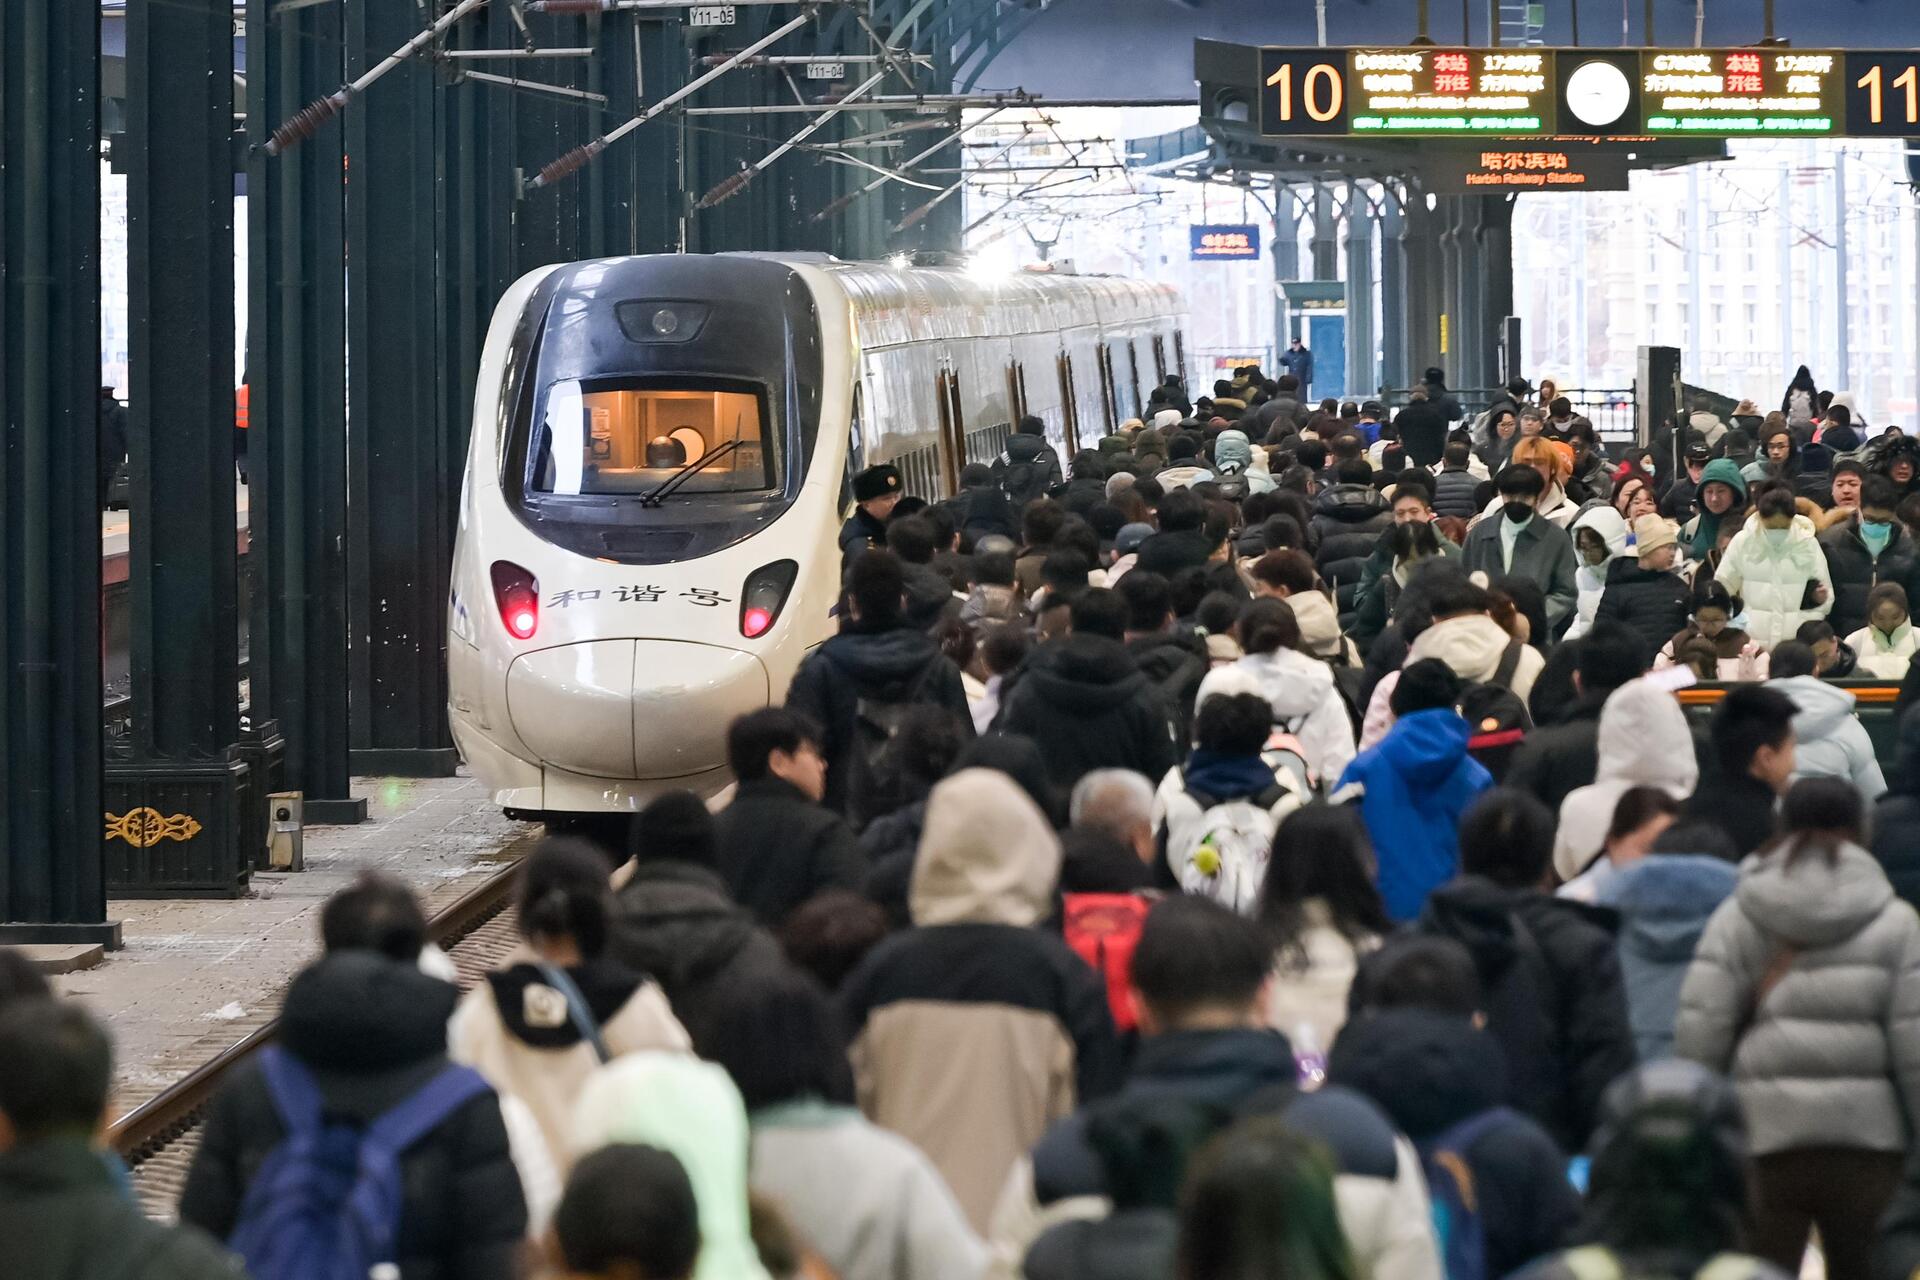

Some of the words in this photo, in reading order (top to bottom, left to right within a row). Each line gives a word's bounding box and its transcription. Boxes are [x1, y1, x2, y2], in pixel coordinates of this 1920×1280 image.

[691, 10, 733, 24] Y11-05
[808, 66, 843, 77] Y11-04
[1434, 54, 1468, 72] 本站
[1726, 55, 1760, 73] 本站
[1434, 74, 1470, 91] 开往
[1728, 75, 1763, 92] 开往
[1266, 63, 1343, 121] 10
[1857, 65, 1918, 123] 11
[1481, 152, 1568, 170] 哈尔滨站
[1465, 173, 1502, 185] Harbin
[1503, 172, 1545, 186] Railway
[1547, 172, 1585, 184] Station
[546, 584, 732, 608] 和谐号
